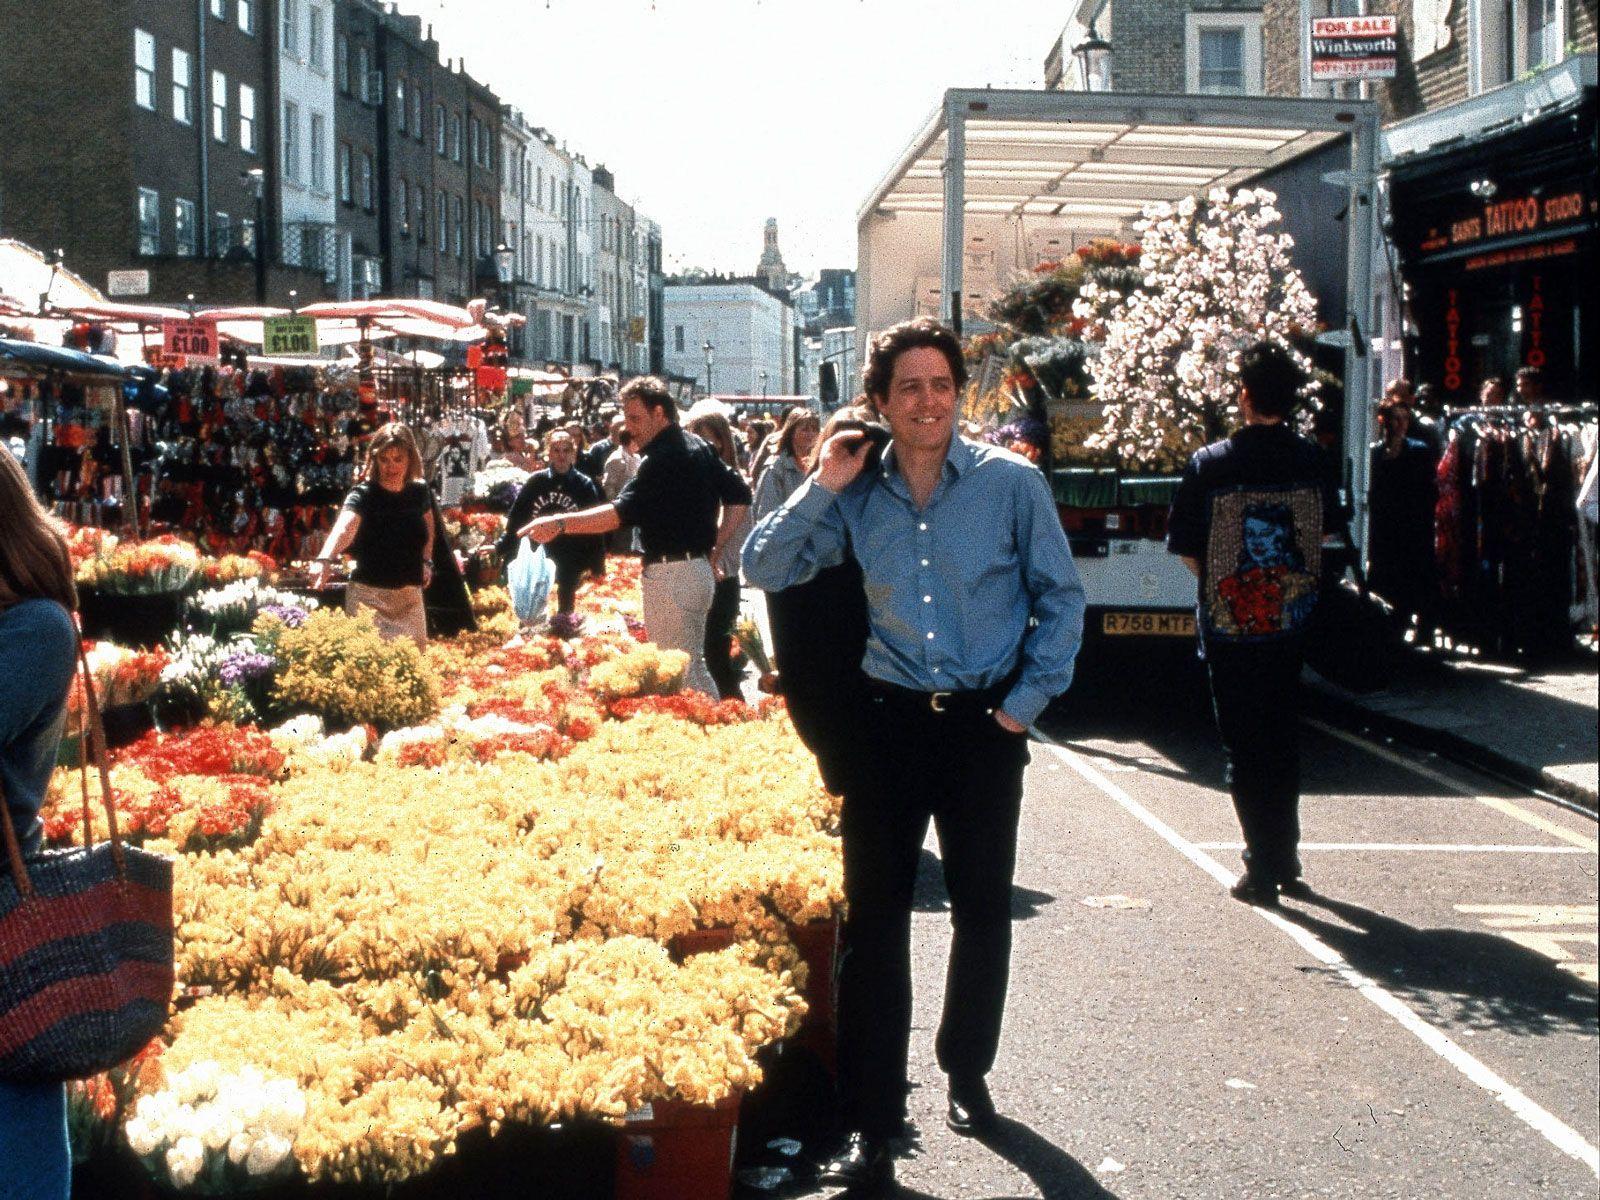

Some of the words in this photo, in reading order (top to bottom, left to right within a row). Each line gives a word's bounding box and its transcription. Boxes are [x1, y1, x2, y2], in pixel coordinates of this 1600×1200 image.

[1316, 21, 1346, 32] FOR
[1352, 19, 1390, 32] SALE
[1313, 37, 1396, 53] Winkworth
[1485, 196, 1538, 235] TATTOO
[172, 335, 209, 352] £1.00
[271, 334, 309, 351] £1.00
[1444, 288, 1461, 391] TATTOO
[1106, 615, 1153, 631] R758
